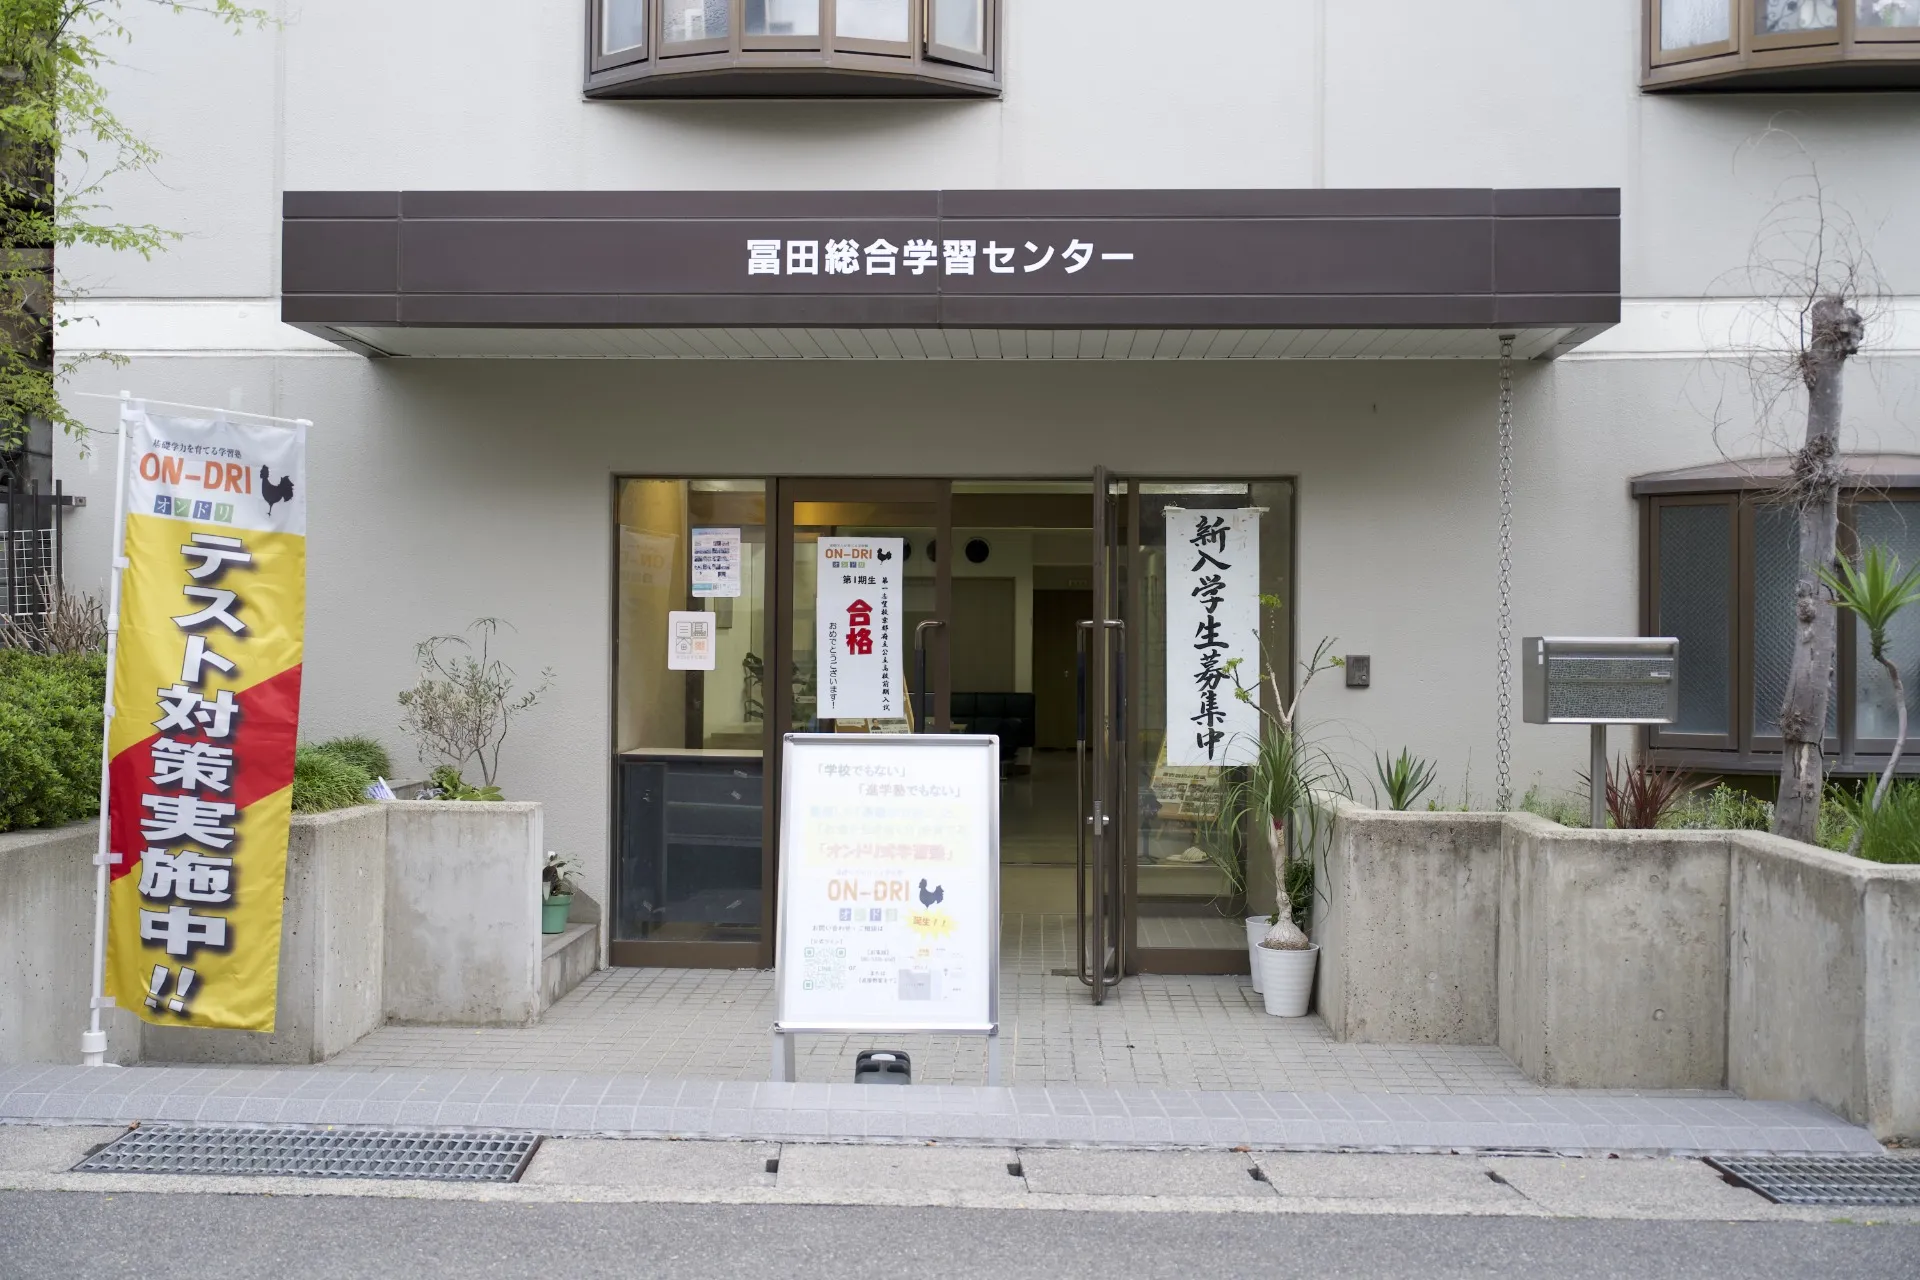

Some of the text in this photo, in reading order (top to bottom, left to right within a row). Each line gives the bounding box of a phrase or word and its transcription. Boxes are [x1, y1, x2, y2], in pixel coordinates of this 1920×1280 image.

[746, 238, 1134, 276] 冨田総合学習センター
[152, 438, 242, 459] 基礎学力を育てる学習塾
[139, 451, 252, 495] ON-DRI
[154, 495, 234, 523] オンドリ
[825, 547, 873, 561] ON-DRI
[845, 598, 874, 656] 合格
[1189, 515, 1232, 761] 新入学生募集中
[827, 878, 911, 903] ON-DRI
